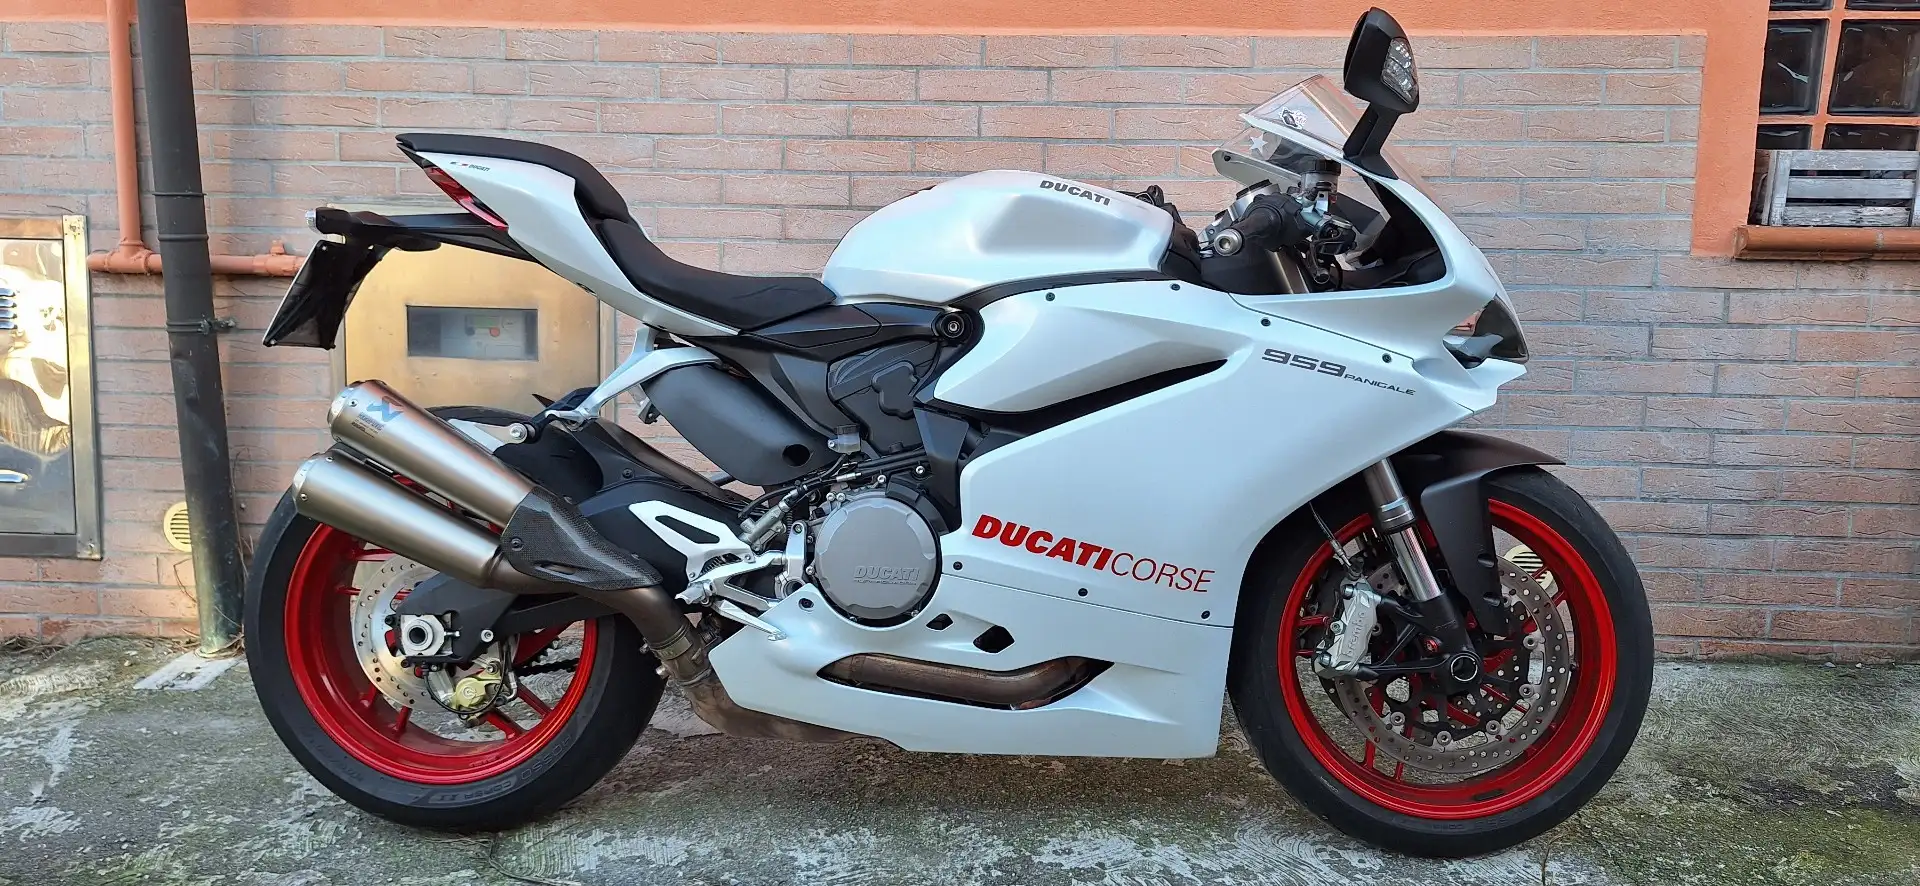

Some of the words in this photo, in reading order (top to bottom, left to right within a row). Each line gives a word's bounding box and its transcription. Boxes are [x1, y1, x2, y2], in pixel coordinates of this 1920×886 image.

[1040, 180, 1110, 206] DUCATI
[1262, 348, 1346, 377] 959
[1344, 374, 1416, 395] PANIGALE
[854, 566, 919, 580] DUCATI
[1341, 612, 1365, 658] brembo
